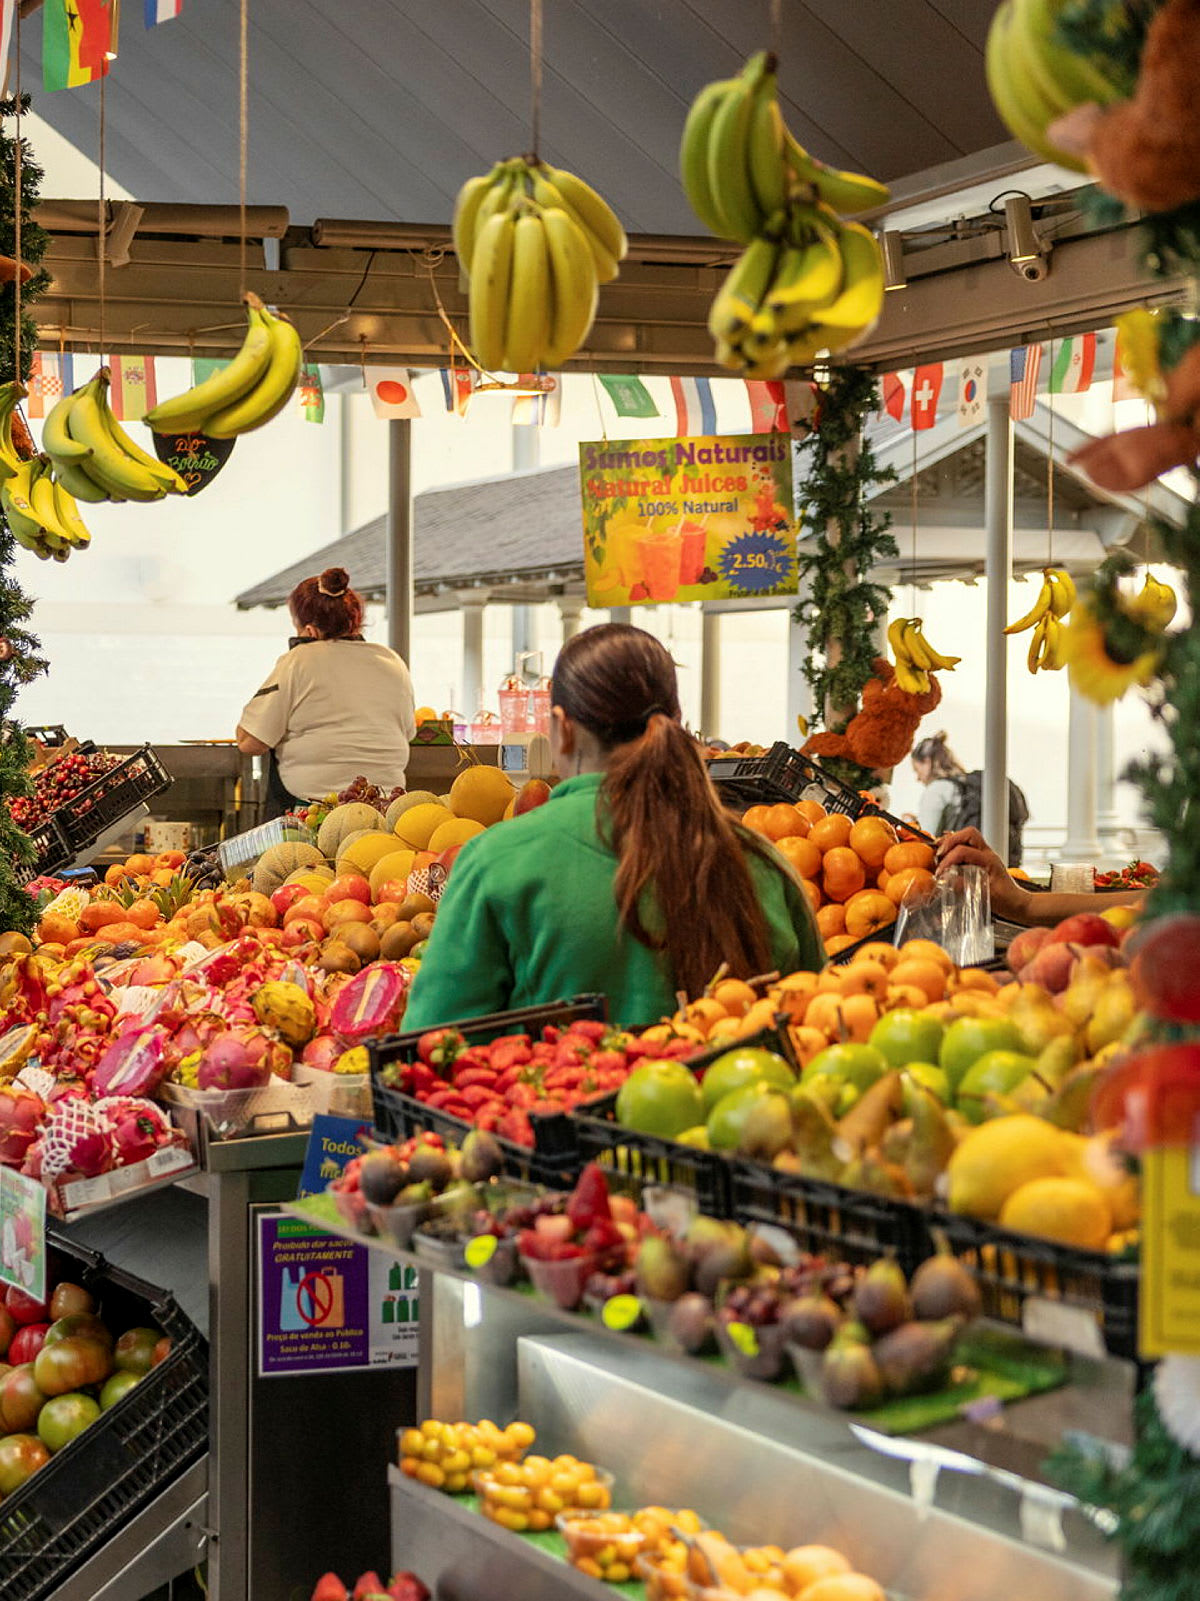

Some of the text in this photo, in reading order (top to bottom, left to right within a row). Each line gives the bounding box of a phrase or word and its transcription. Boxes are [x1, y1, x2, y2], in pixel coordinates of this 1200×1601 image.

[586, 439, 786, 470] Sumos Naturais
[587, 473, 748, 499] Natural Juices
[638, 497, 739, 517] 100% Natural
[321, 1137, 362, 1156] Todos
[273, 1241, 310, 1251] Proibido
[311, 1240, 327, 1249] dar
[274, 1250, 355, 1263] GRATUITAMENTE
[300, 1331, 324, 1340] venda
